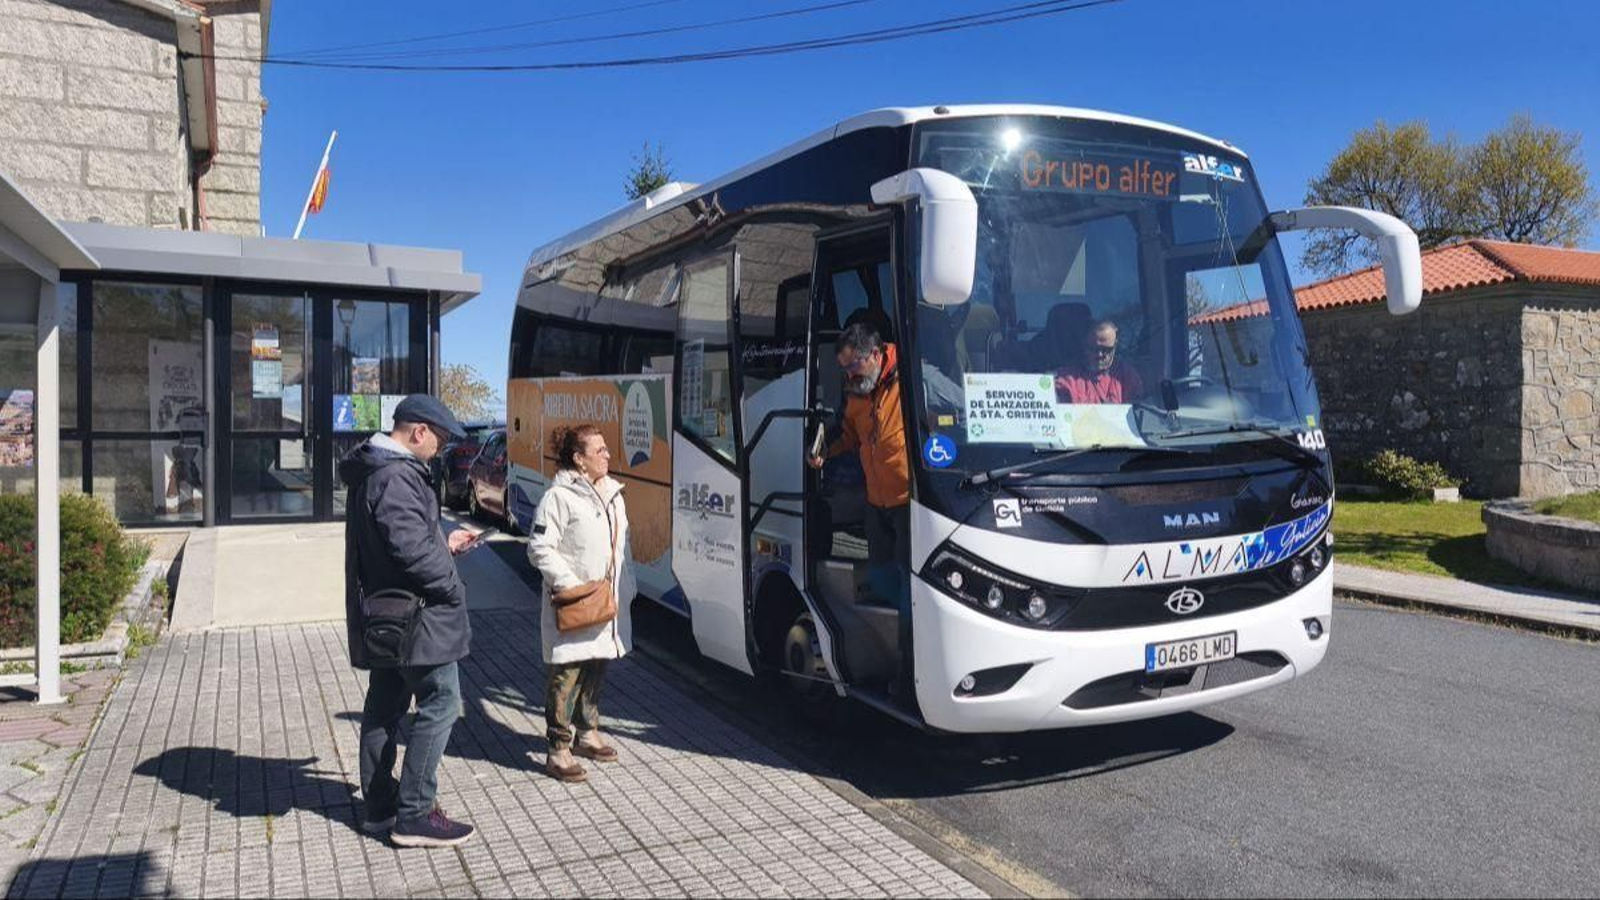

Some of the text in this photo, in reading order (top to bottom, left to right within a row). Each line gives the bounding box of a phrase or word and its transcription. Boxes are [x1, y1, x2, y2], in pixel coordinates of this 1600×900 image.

[1022, 150, 1177, 196] Grupo alfer
[1183, 153, 1243, 180] alfer
[544, 393, 619, 423] RIBEIRA SACRA
[970, 400, 1051, 409] DE LANZADERA
[985, 390, 1035, 400] SERVICIO
[969, 410, 1056, 420] A STA. CRISTINA
[1297, 429, 1326, 450] 140
[678, 483, 735, 513] alfer
[1163, 512, 1220, 528] MAN
[1122, 541, 1249, 582] ALMA
[1276, 511, 1327, 562] Galicia
[1158, 637, 1232, 666] 0466 LMD
